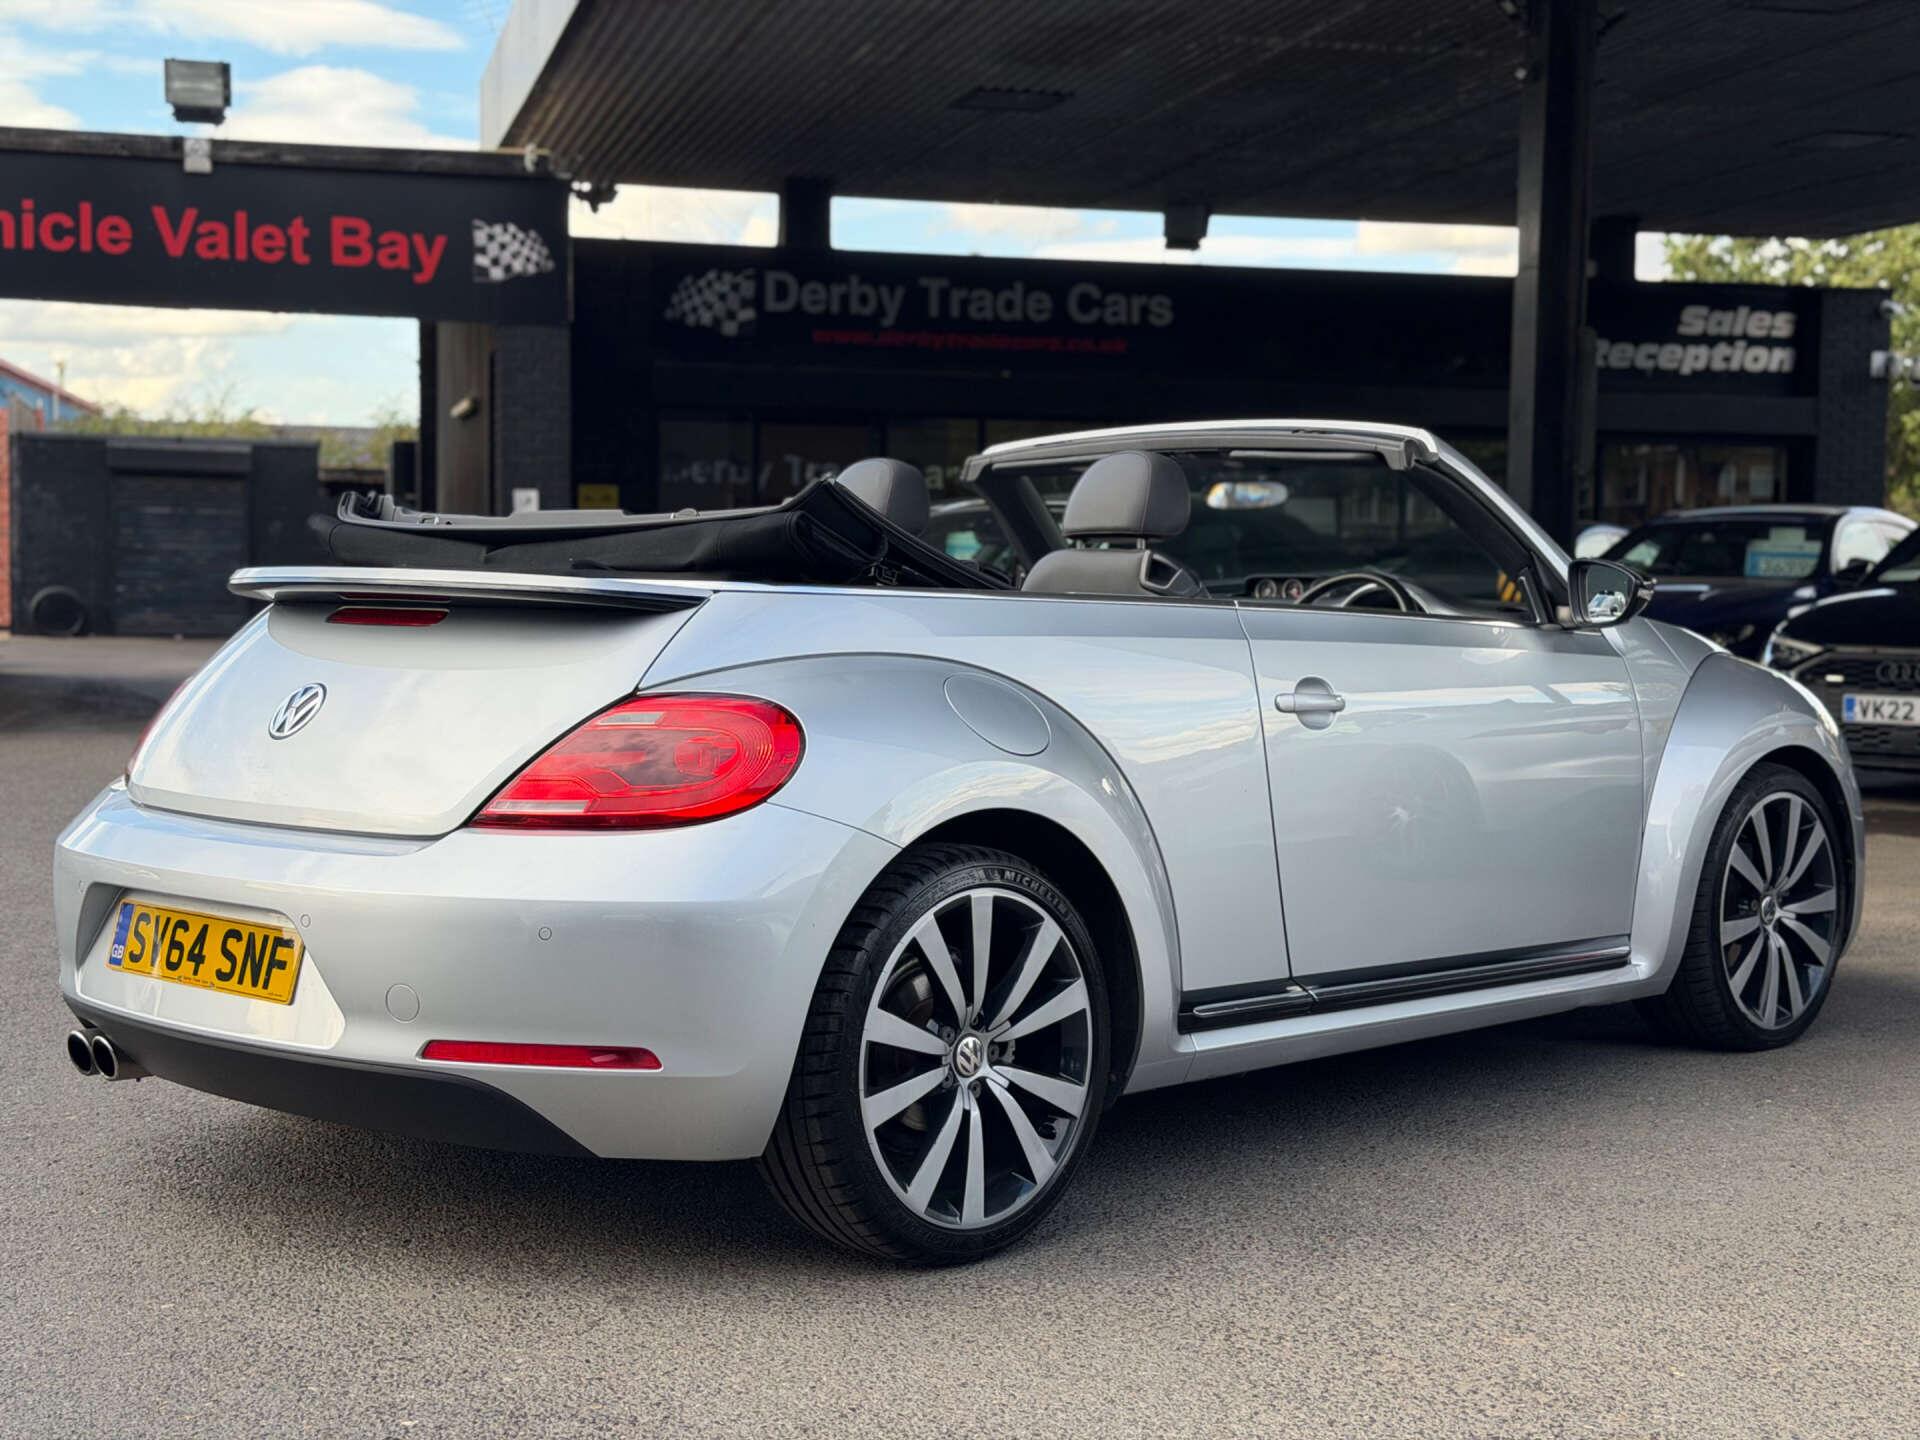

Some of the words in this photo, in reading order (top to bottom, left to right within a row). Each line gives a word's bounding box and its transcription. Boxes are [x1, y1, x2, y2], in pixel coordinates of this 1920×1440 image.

[151, 205, 312, 265] Valet
[331, 215, 449, 285] Bay
[764, 270, 906, 327] Derby
[919, 277, 1053, 322] Trade
[1067, 282, 1175, 327] Cars
[1677, 305, 1796, 339] Sales
[1859, 699, 1915, 721] VK22
[112, 943, 125, 959] GB
[128, 911, 210, 977] SV64
[215, 928, 296, 990] SNF
